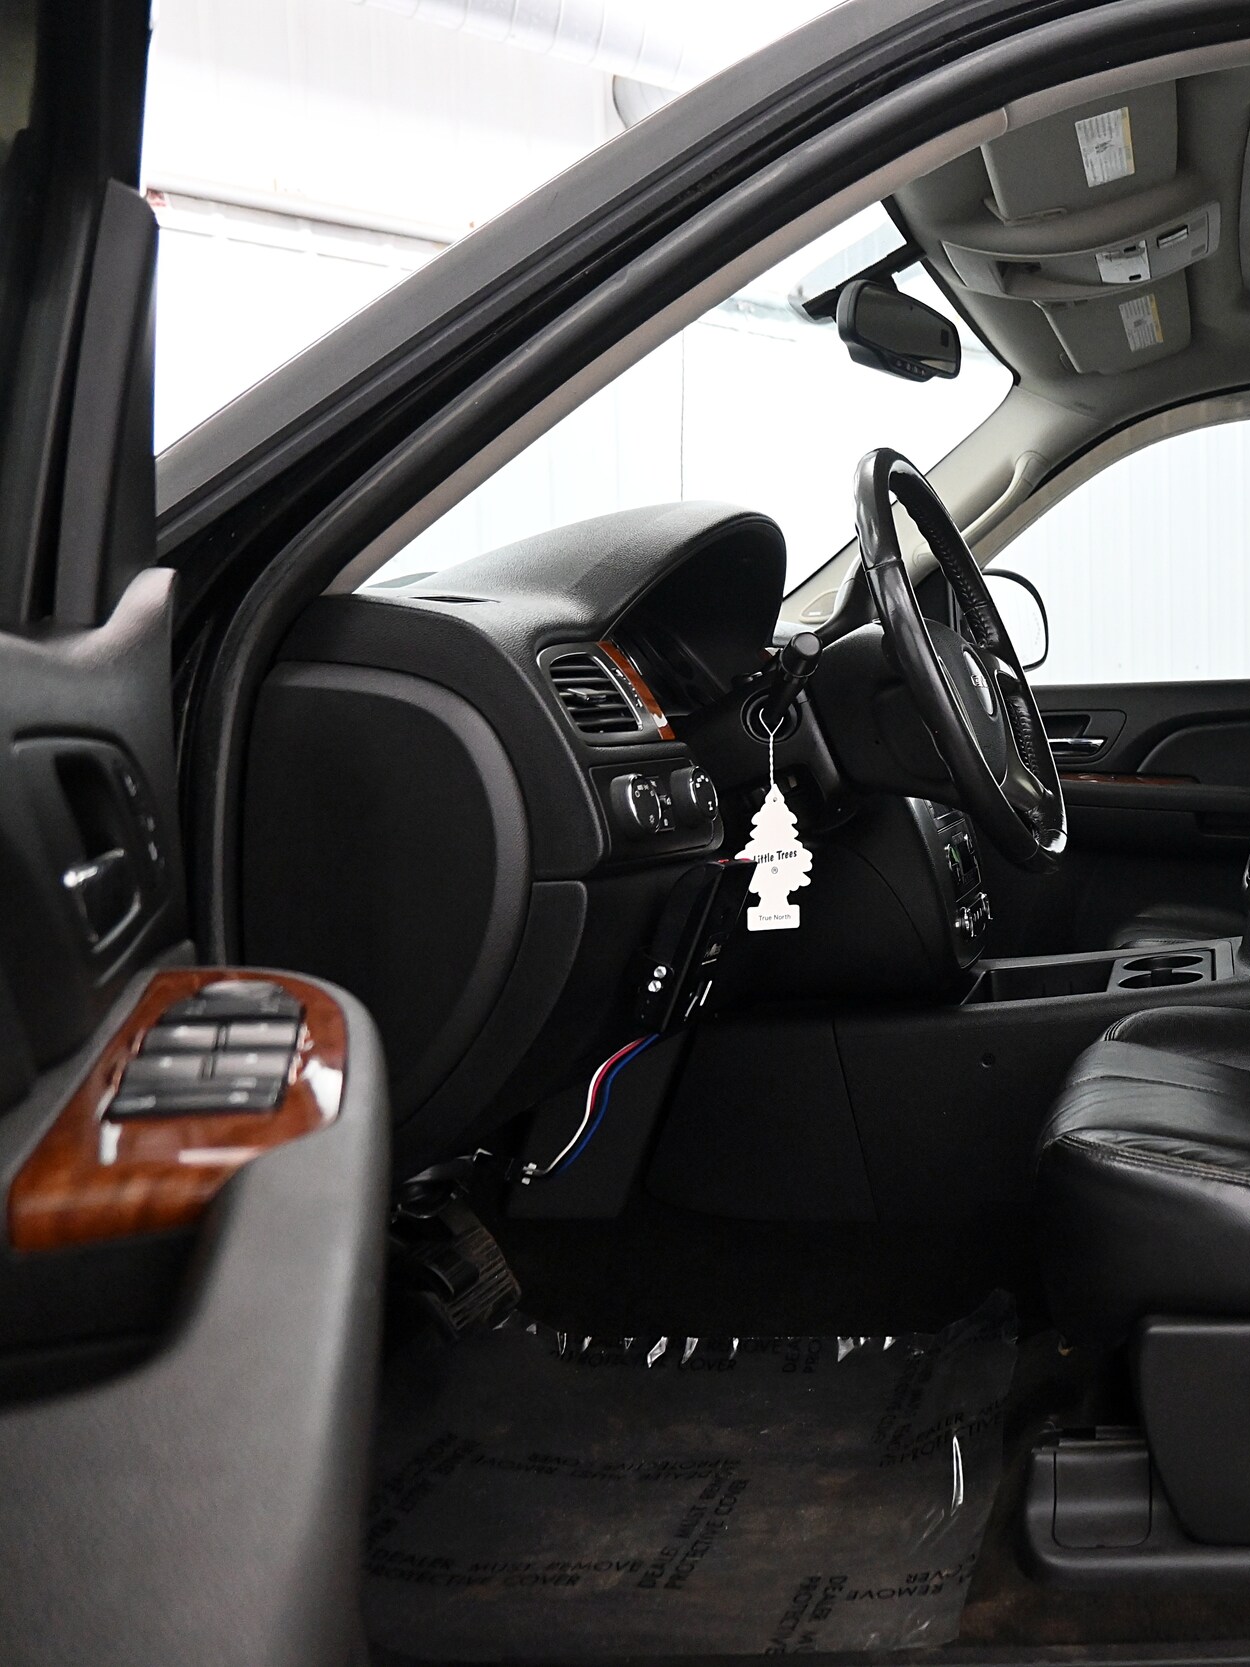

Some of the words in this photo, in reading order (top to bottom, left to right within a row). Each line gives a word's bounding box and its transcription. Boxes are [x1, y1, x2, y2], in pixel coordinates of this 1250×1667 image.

[753, 852, 775, 864] Little
[776, 850, 798, 861] Trees
[773, 913, 791, 921] North
